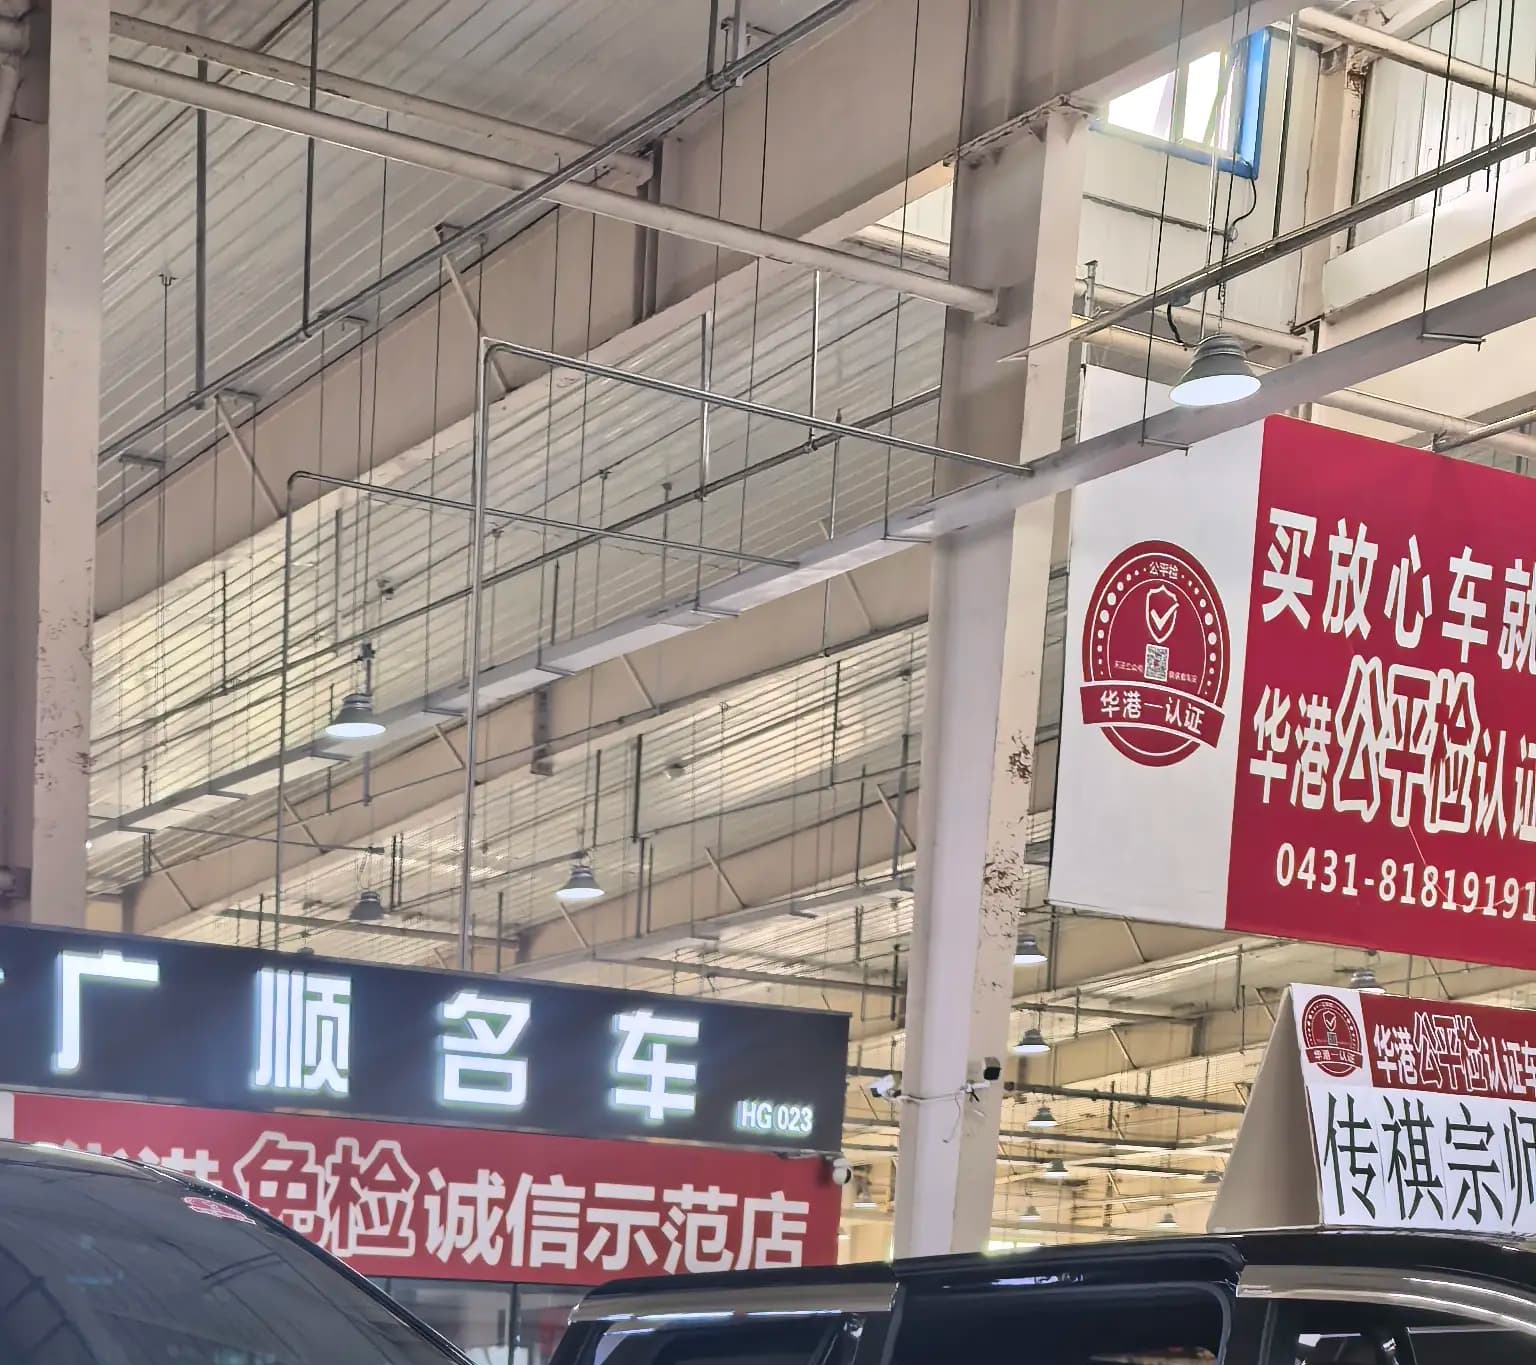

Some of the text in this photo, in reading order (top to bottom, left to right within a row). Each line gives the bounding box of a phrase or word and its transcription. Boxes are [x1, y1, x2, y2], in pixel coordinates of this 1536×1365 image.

[55, 948, 814, 1135] 广顺名车 HG 023
[61, 1131, 811, 1274] 免检诚信示范店
